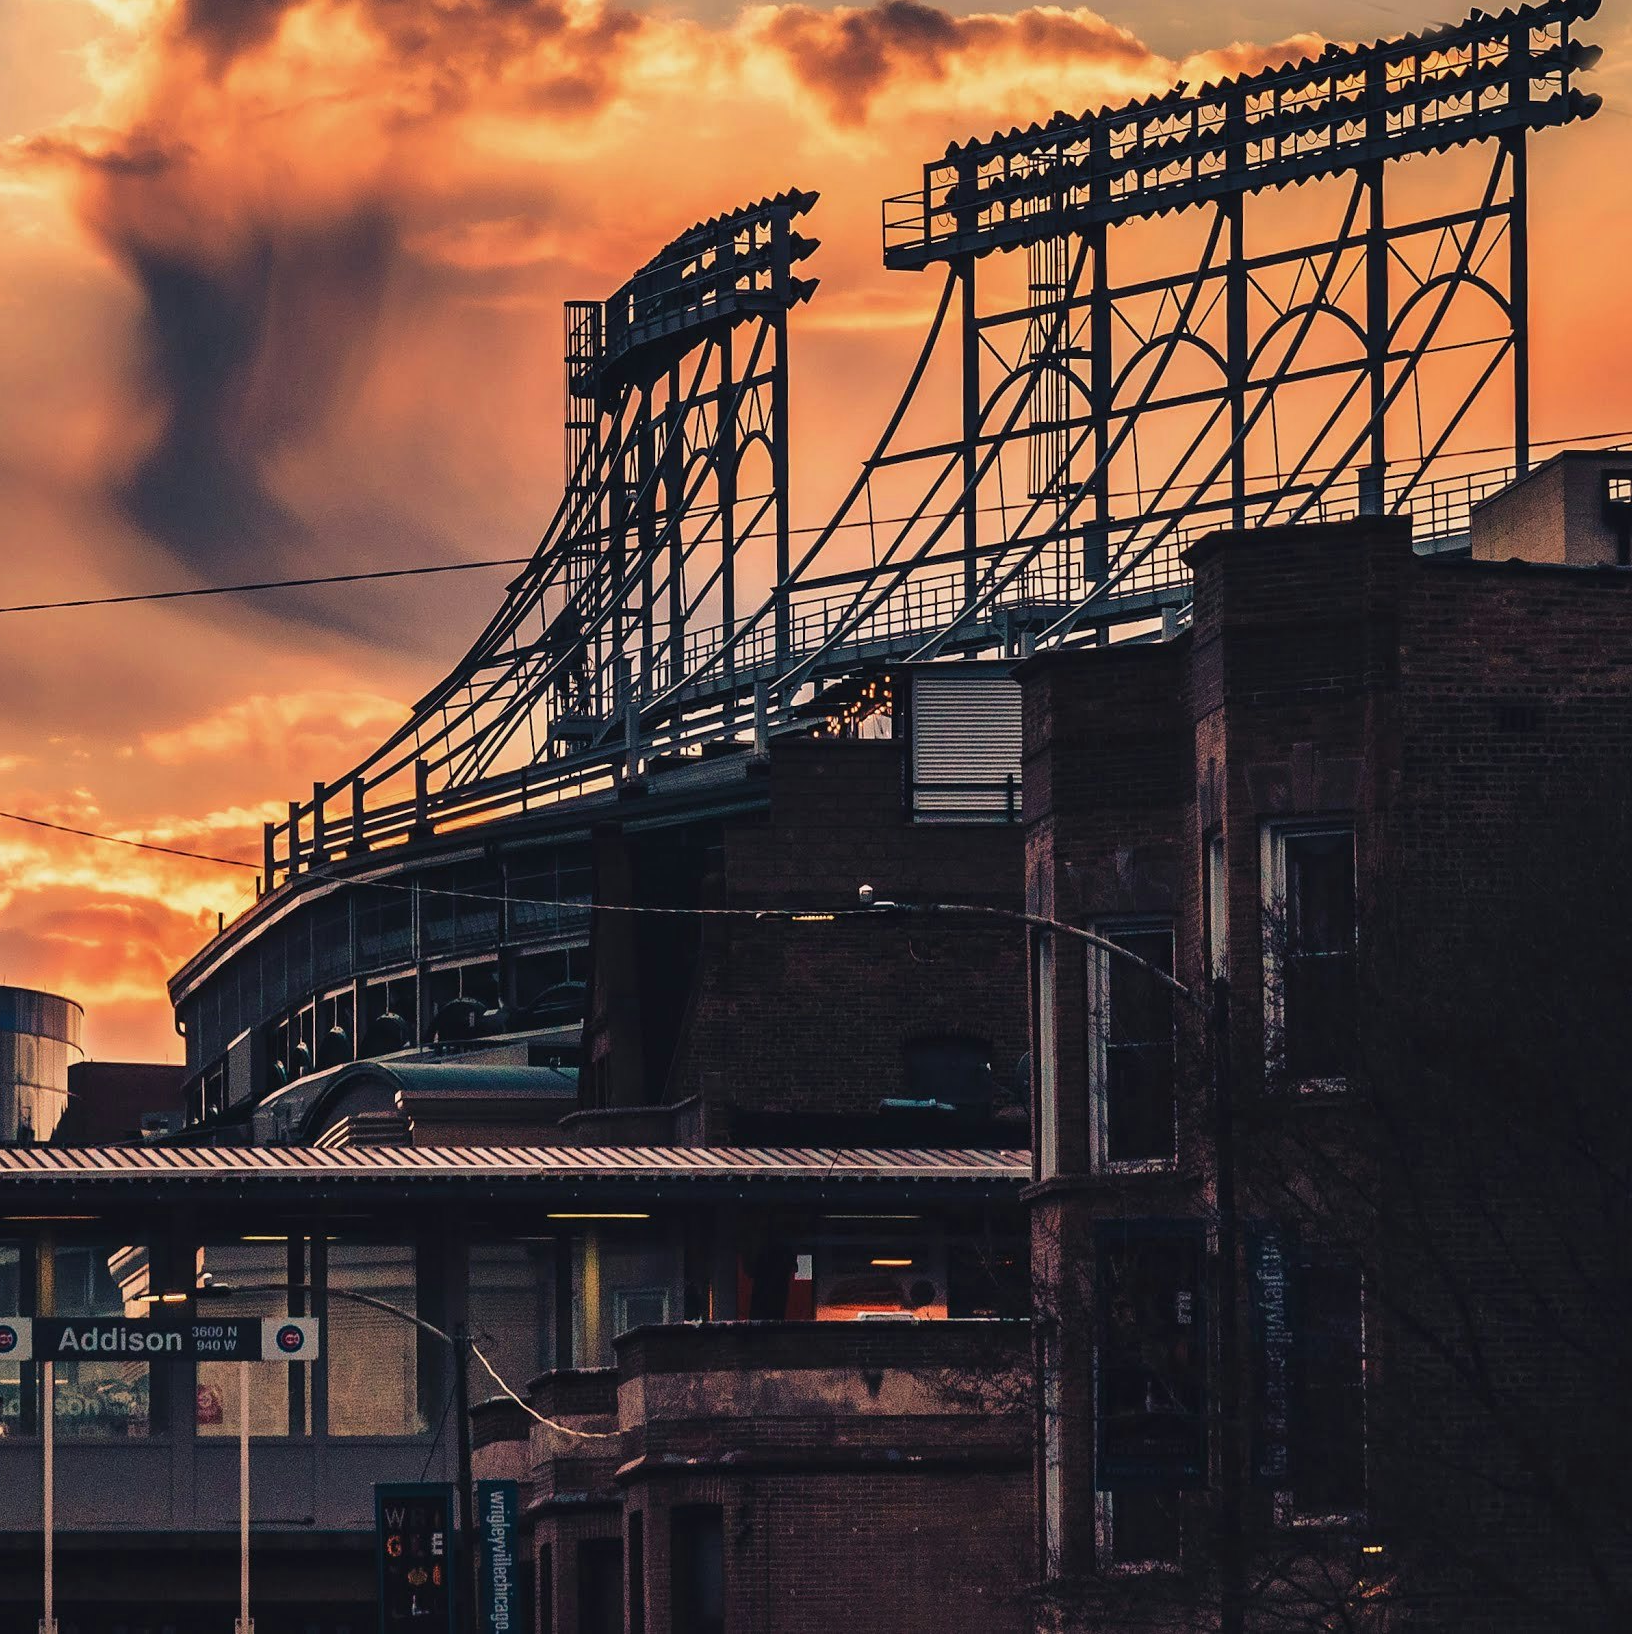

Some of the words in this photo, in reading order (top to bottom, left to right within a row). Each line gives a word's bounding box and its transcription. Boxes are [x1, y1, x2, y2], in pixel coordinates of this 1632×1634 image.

[192, 1326, 223, 1338] 3600
[227, 1326, 238, 1337] N
[58, 1327, 183, 1352] Addison
[196, 1340, 221, 1351] 940
[223, 1340, 237, 1351] W
